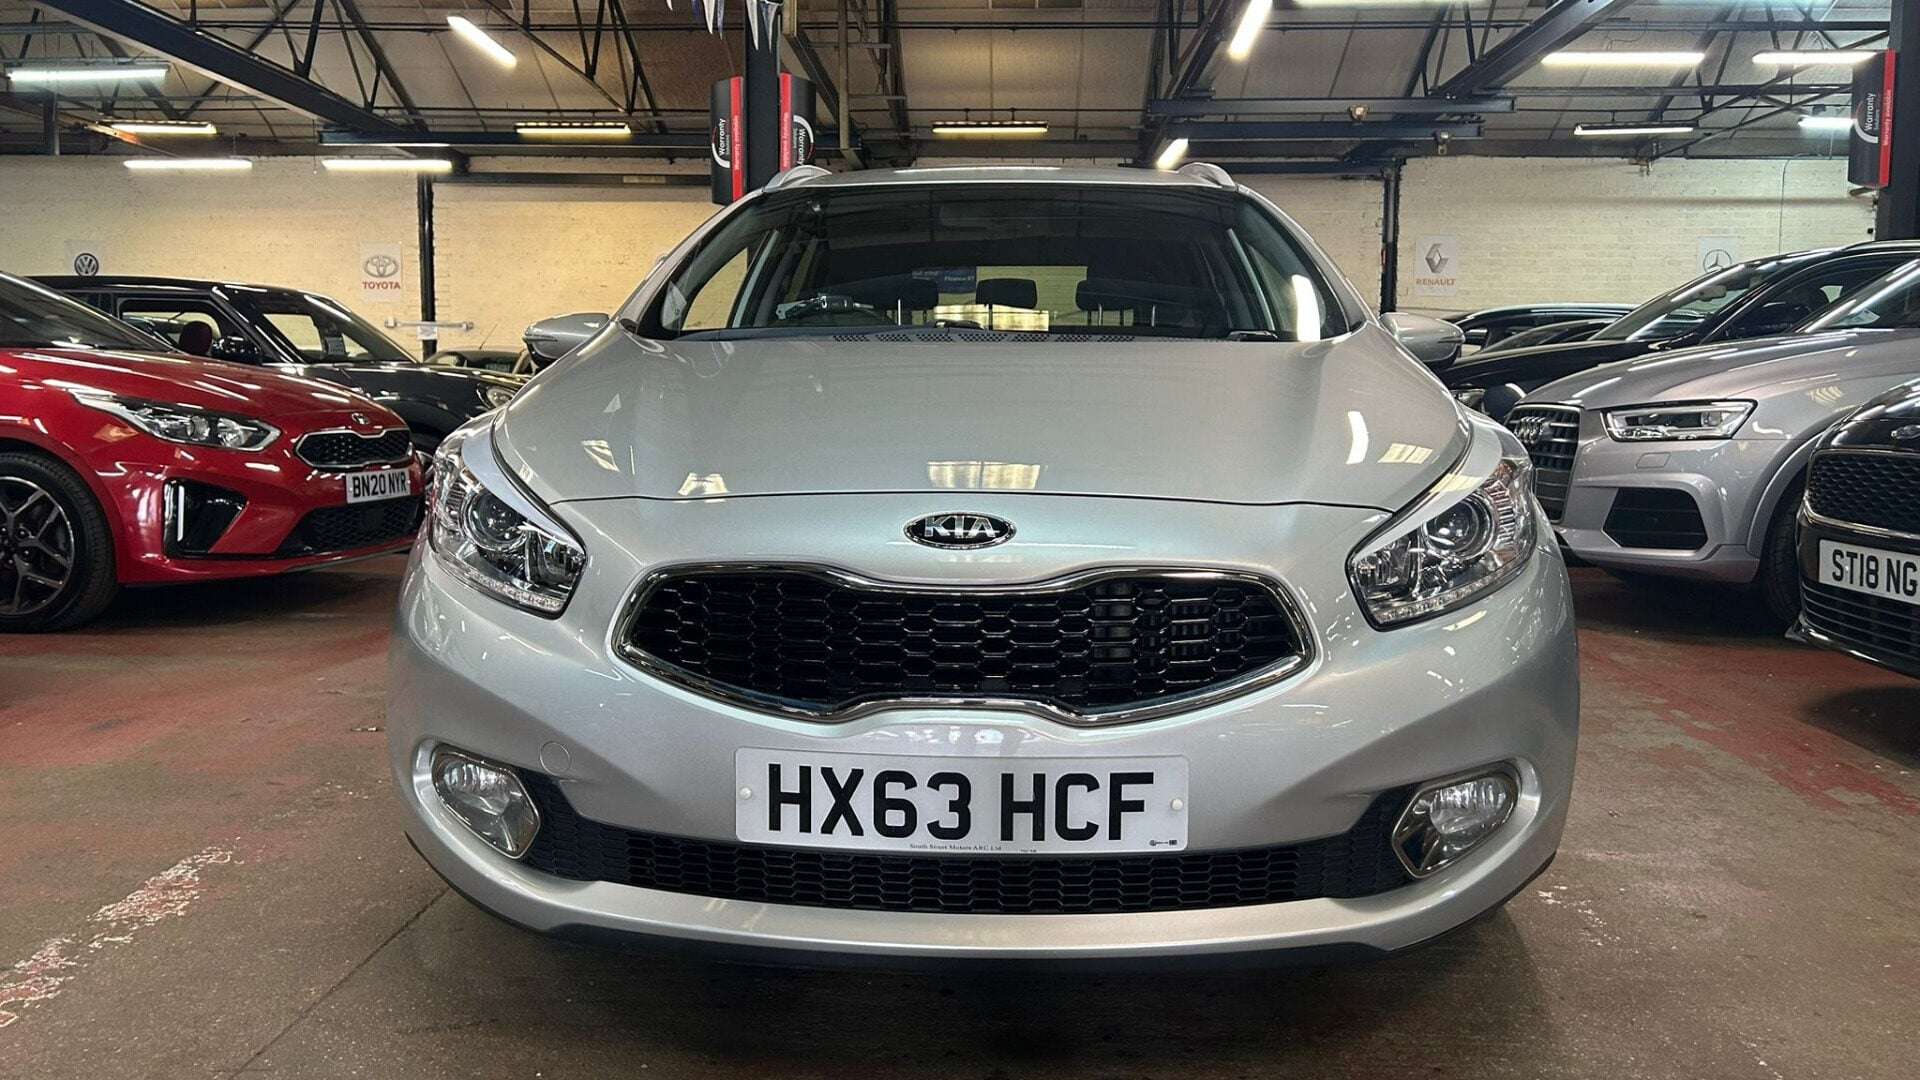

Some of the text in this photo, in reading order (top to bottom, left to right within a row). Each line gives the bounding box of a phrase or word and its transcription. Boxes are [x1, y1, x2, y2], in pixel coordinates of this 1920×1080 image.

[1864, 93, 1876, 131] Warranty
[718, 118, 726, 156] Warranty
[362, 281, 401, 290] TOYOTA
[1415, 278, 1456, 286] RENAULT
[352, 471, 407, 498] BN20 NYR
[924, 515, 1000, 539] KIA
[1832, 549, 1918, 597] ST18 NG
[768, 763, 1154, 842] HX63 HCF
